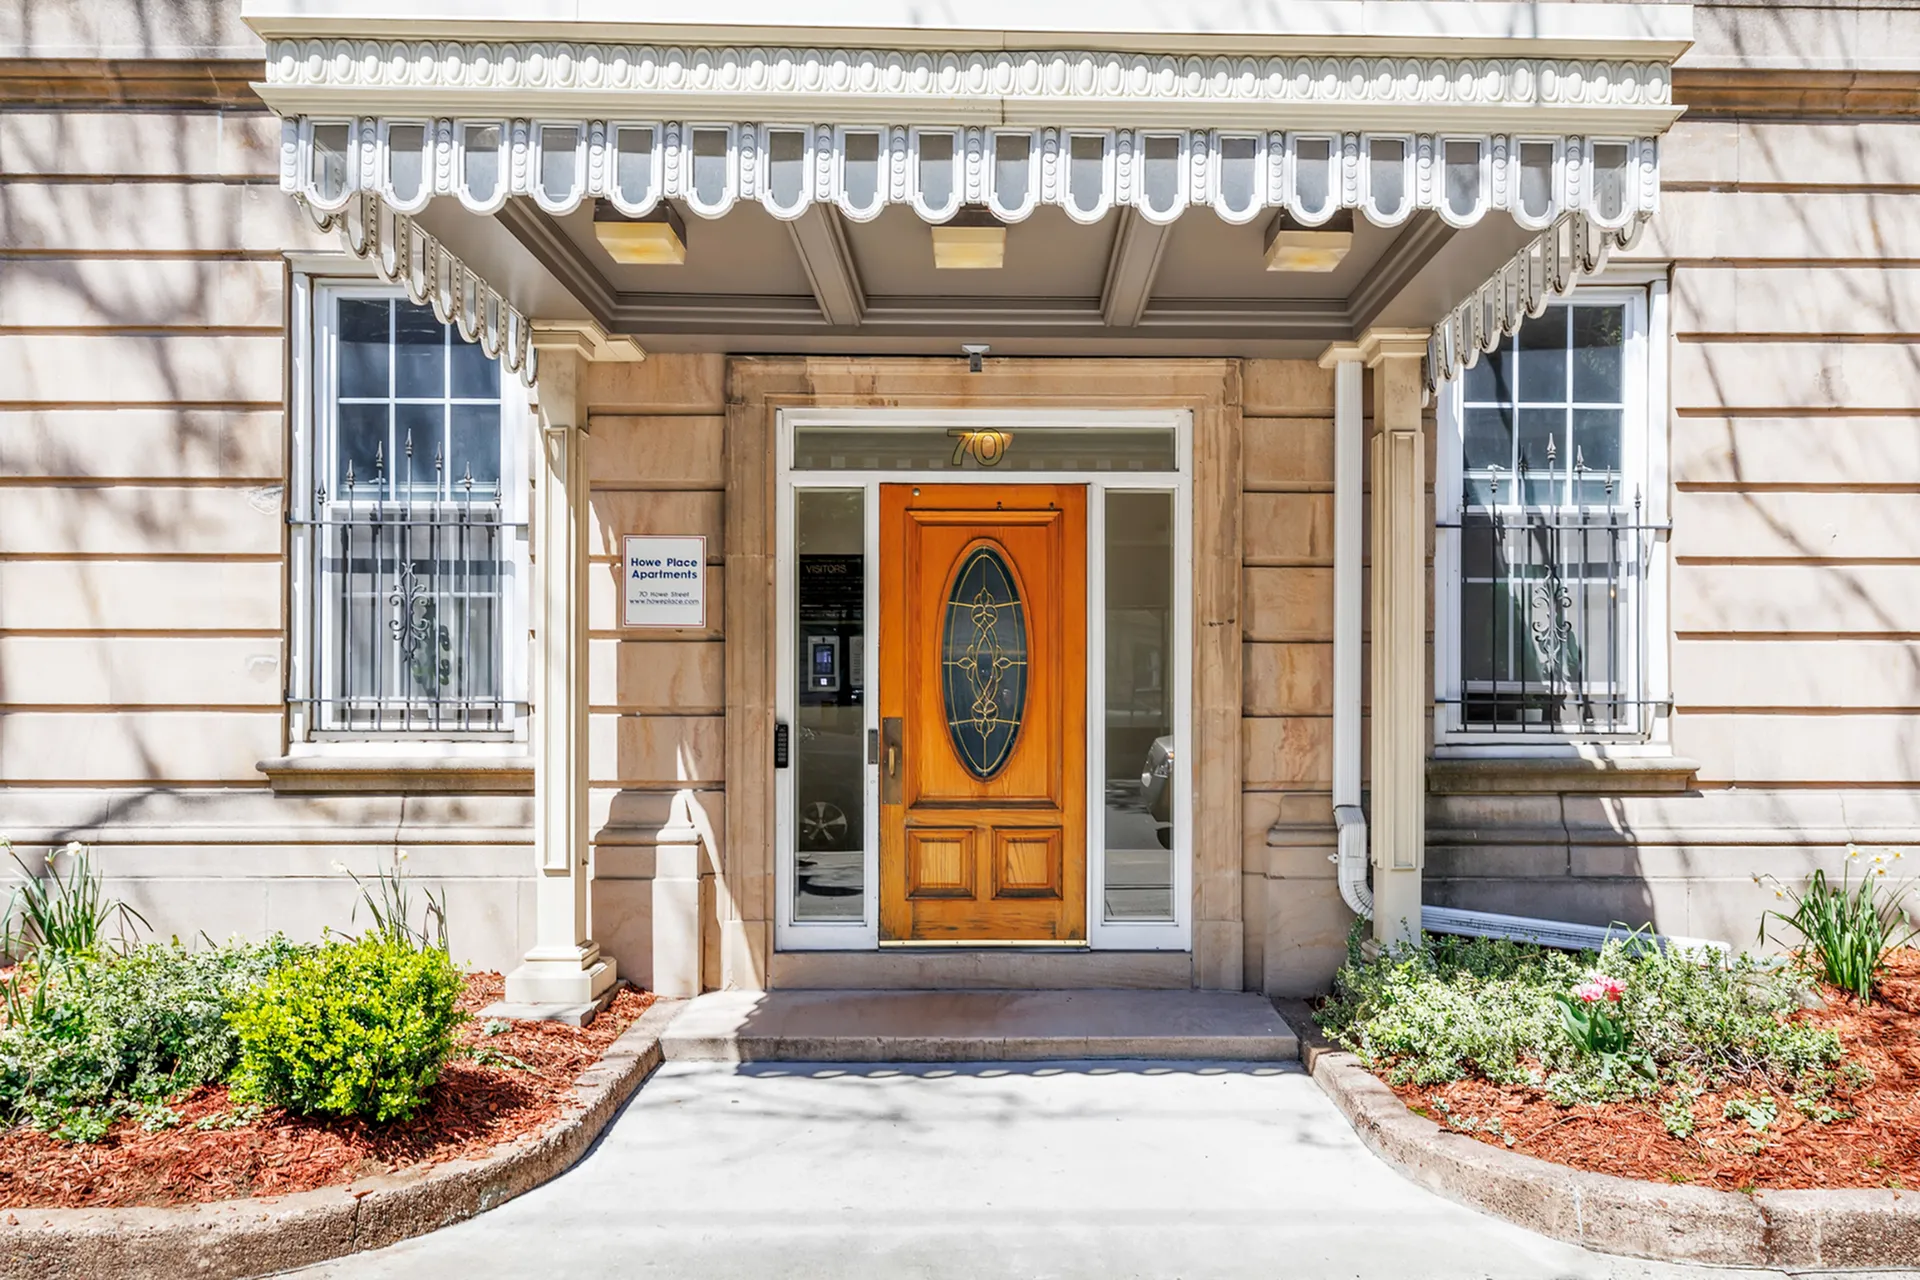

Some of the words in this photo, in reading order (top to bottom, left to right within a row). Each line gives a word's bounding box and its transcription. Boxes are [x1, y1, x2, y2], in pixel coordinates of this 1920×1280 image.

[947, 427, 1005, 467] 70
[631, 558, 661, 567] Howe
[666, 558, 698, 567] Place
[805, 564, 847, 574] VISITORS
[632, 570, 698, 580] Apartments
